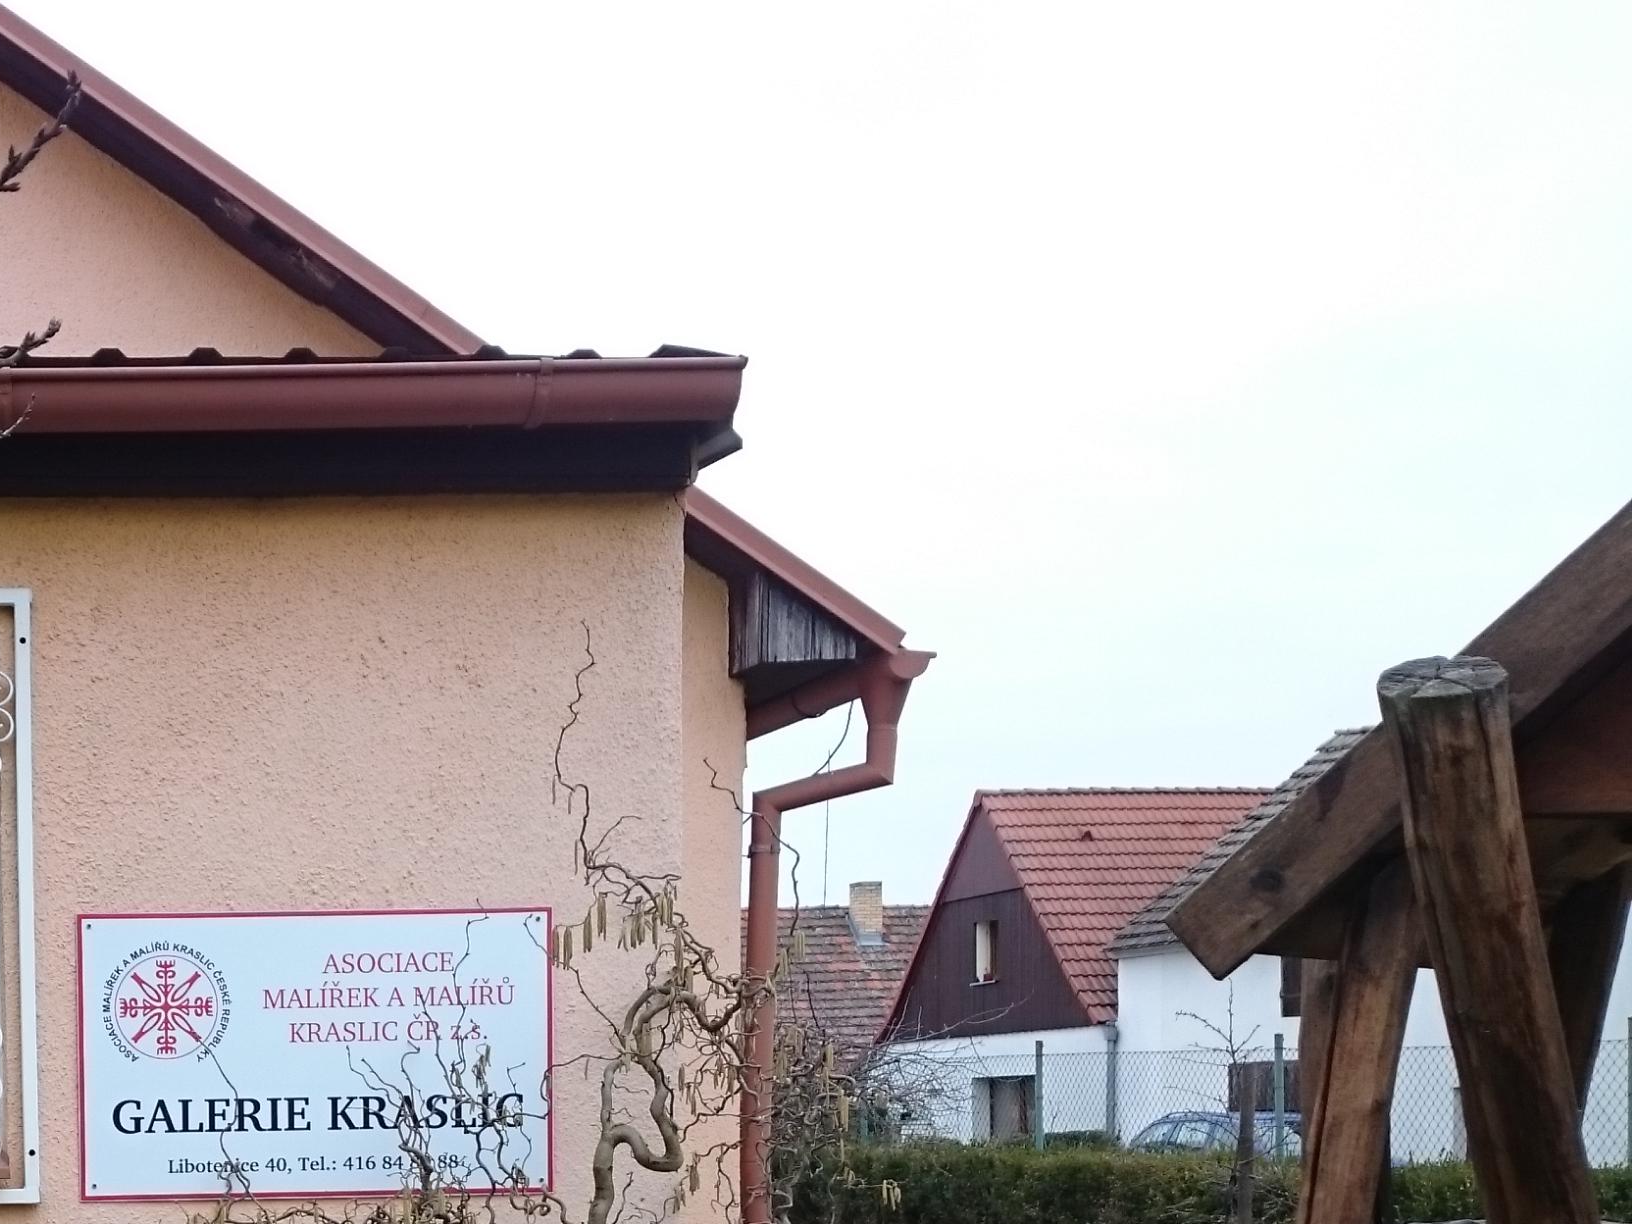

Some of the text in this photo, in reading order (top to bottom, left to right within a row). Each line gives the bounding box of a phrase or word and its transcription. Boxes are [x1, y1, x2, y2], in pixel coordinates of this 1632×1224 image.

[322, 952, 455, 974] ASOCIACE
[102, 940, 232, 1063] ASOCIACE MALÍŘEK A MALÍŘŮ KRASLIC ČESKÉ REPUBLKY
[262, 976, 515, 1009] MALÍŘEK A MALÍŘŮ
[289, 1020, 399, 1043] KRASLIC
[407, 1013, 442, 1041] ČR
[112, 1093, 523, 1134] GALERIE KRASLIC
[265, 1157, 292, 1174] 40,
[298, 1156, 336, 1171] Tel.:
[343, 1155, 376, 1170] 416
[382, 1155, 404, 1170] 84
